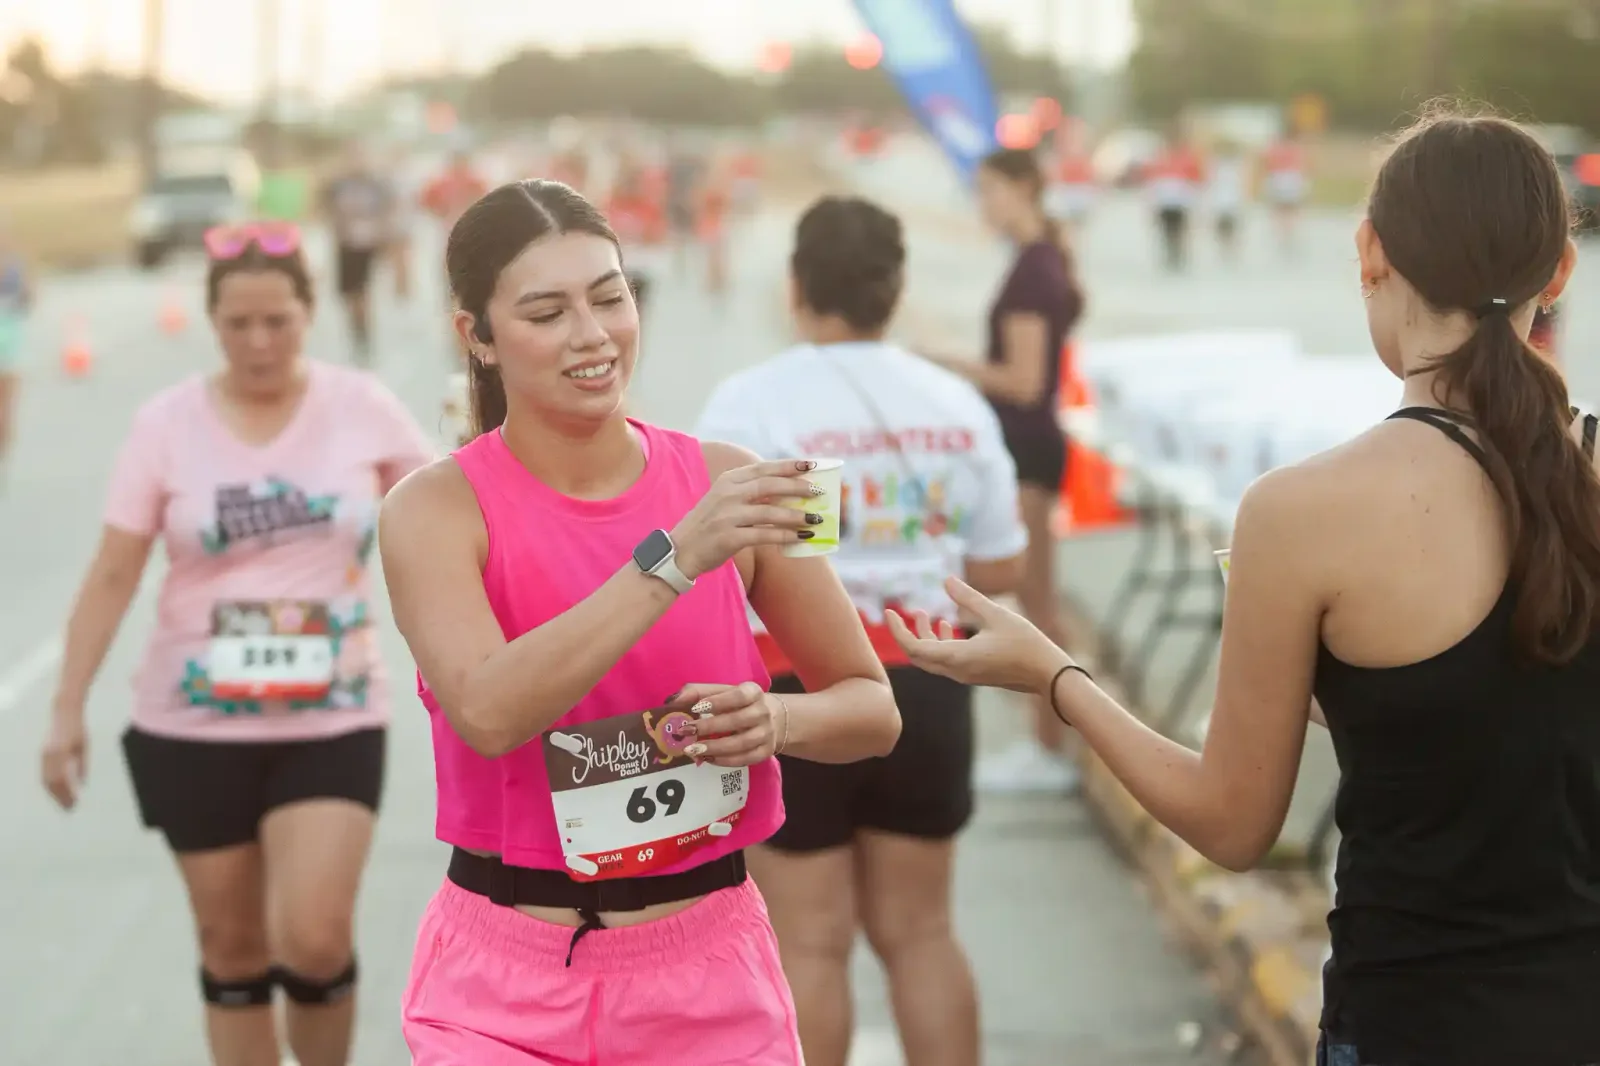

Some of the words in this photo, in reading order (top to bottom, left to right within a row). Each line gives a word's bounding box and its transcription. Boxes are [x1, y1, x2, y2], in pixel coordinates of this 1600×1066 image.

[569, 730, 650, 783] Shipley
[614, 760, 640, 771] Donut
[620, 767, 641, 777] Dash
[626, 779, 685, 823] 69
[598, 852, 622, 864] GEAR
[638, 847, 654, 862] 69
